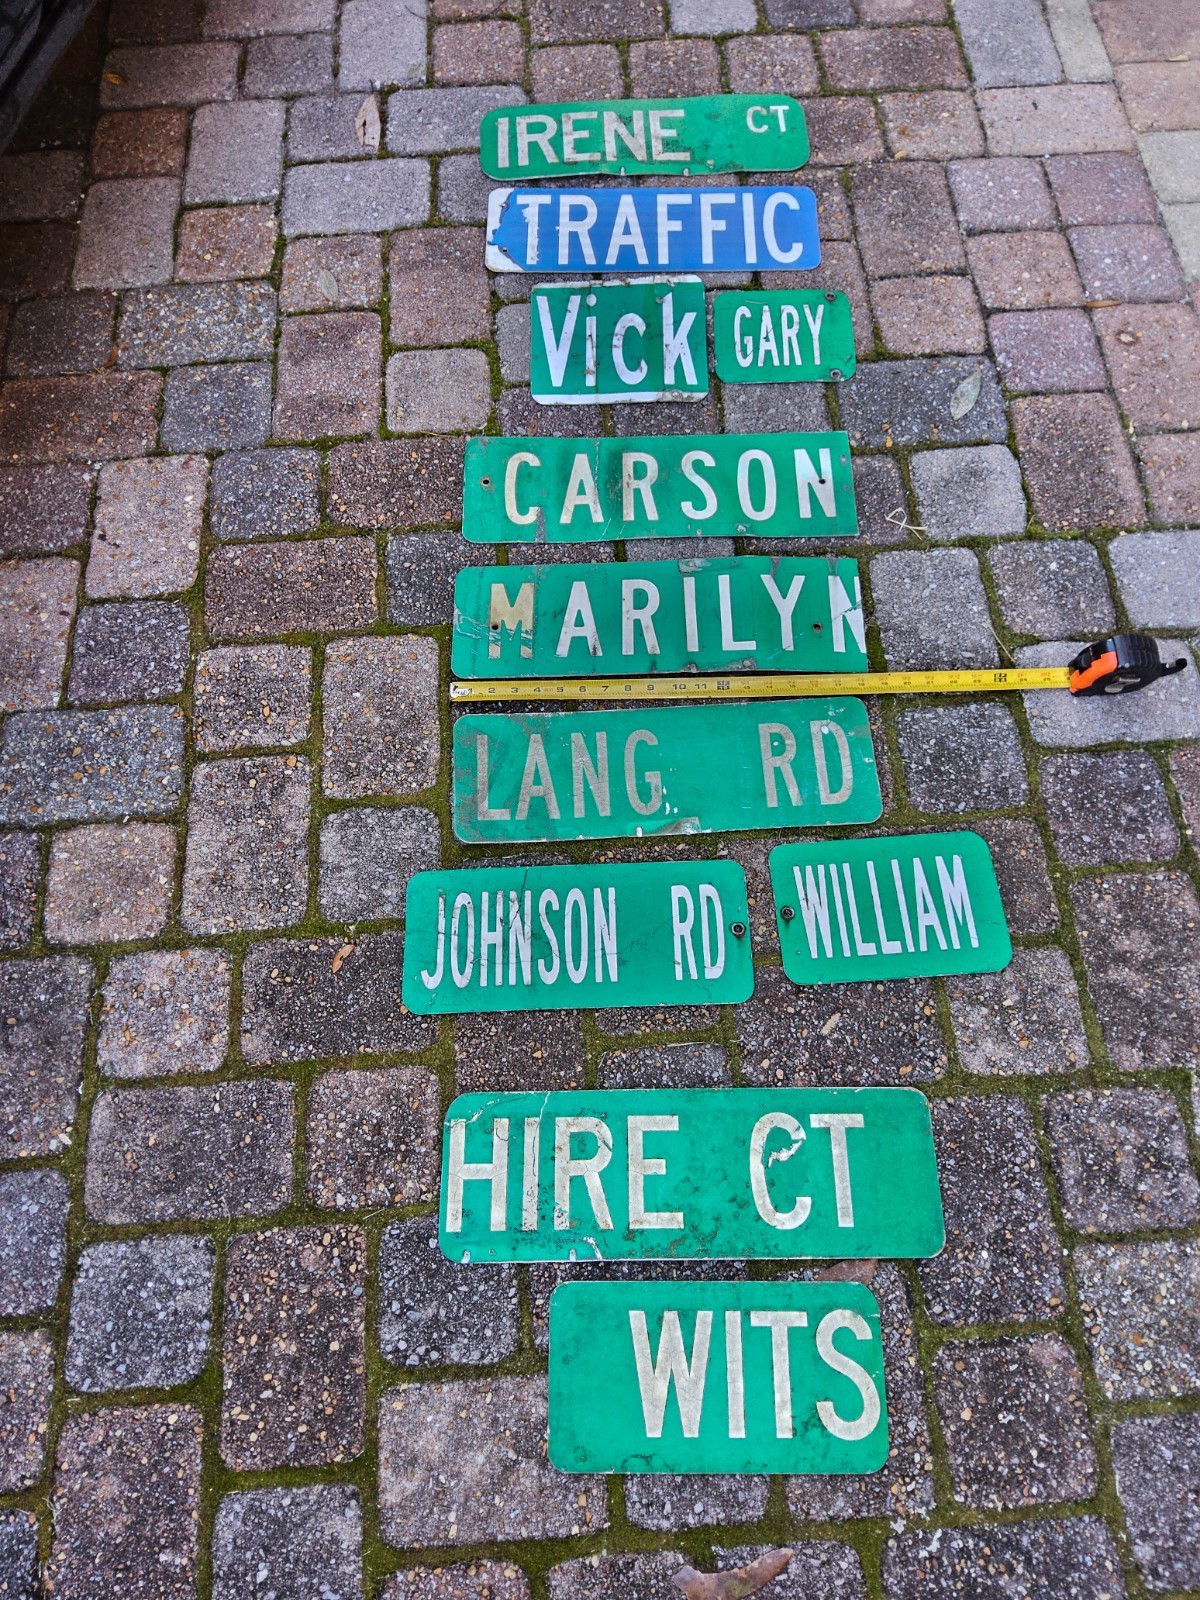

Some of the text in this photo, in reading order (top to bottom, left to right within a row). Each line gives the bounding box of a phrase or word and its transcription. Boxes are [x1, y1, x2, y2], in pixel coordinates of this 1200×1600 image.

[495, 105, 790, 169] IRENE CT
[516, 191, 804, 266] TRAFFIC
[536, 290, 698, 388] Vick
[733, 303, 825, 368] GARY
[503, 448, 837, 525] CARSON
[487, 573, 867, 660] MARILYN
[475, 719, 853, 821] LANG RD
[420, 883, 726, 990] JOHNSON RD
[792, 854, 979, 960] WILLIAM
[445, 1111, 865, 1233] HIRE CT
[628, 1309, 881, 1442] WITS
